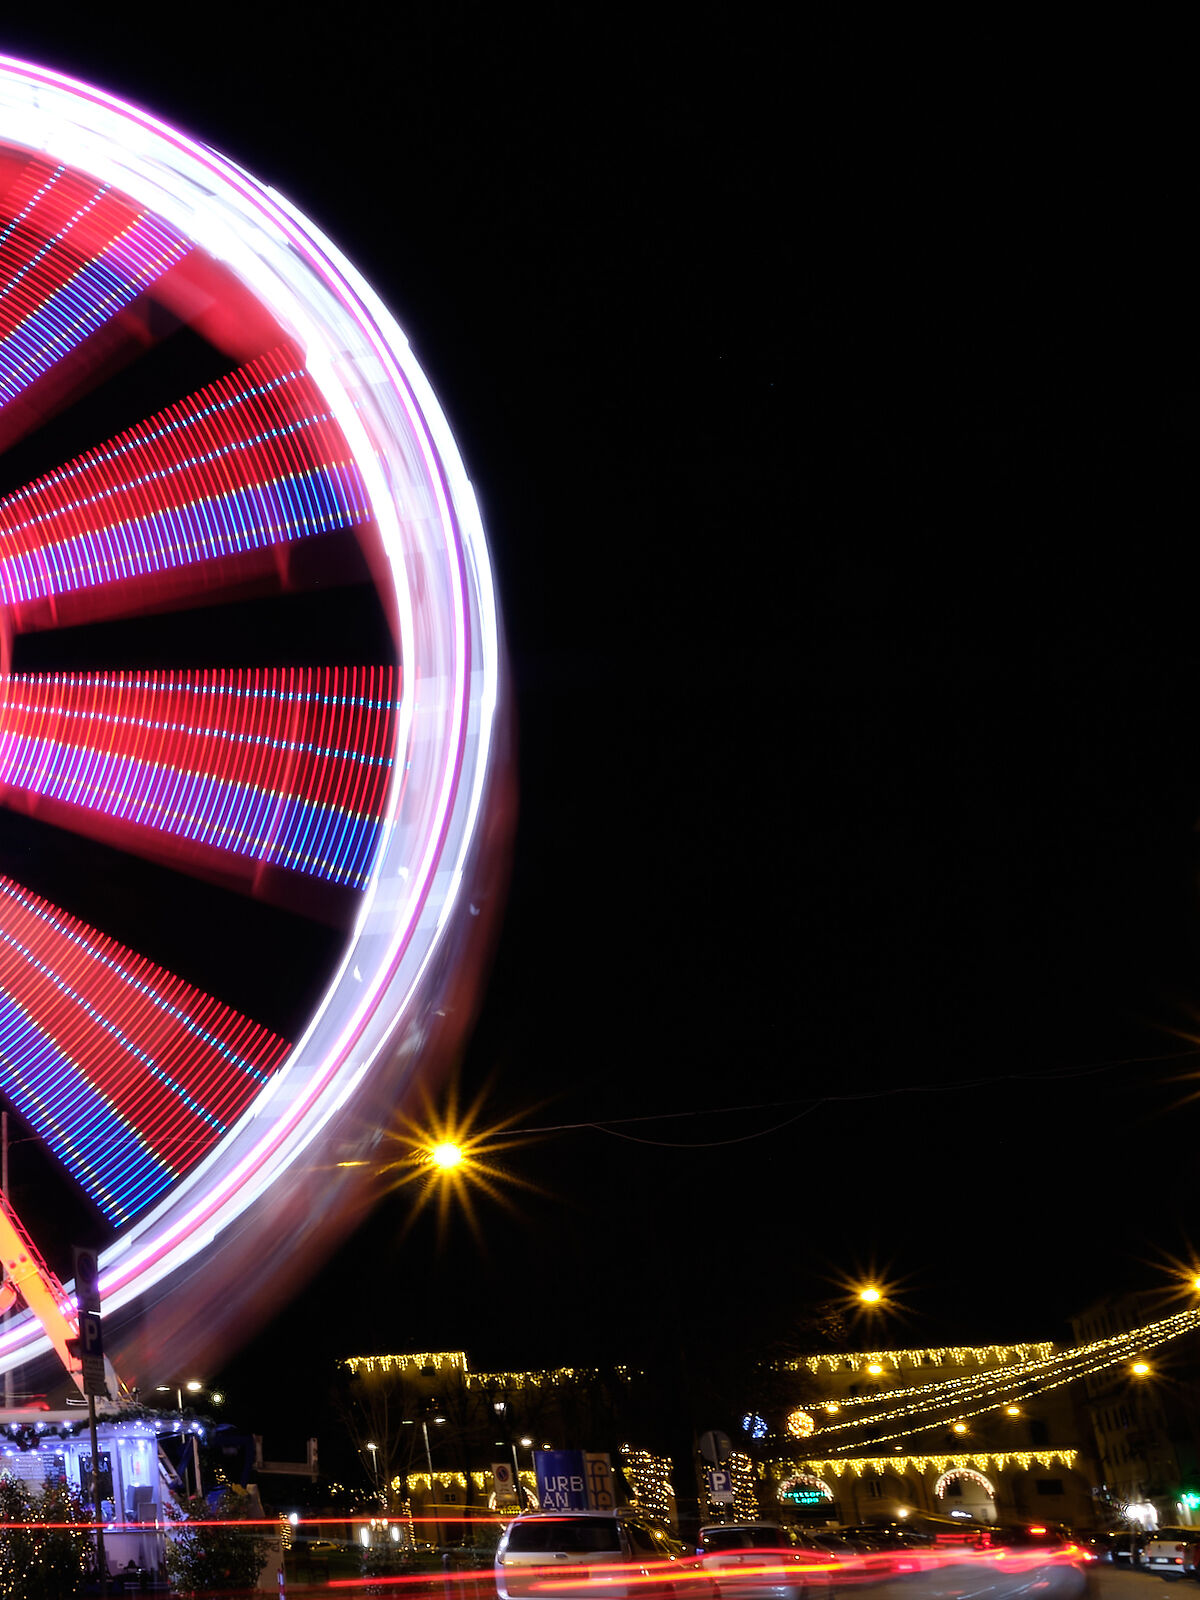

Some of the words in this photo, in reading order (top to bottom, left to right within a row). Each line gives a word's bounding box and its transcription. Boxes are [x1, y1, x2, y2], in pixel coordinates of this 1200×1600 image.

[85, 1319, 98, 1351] P
[544, 1475, 584, 1492] URB
[711, 1472, 726, 1491] P
[542, 1492, 570, 1508] AN
